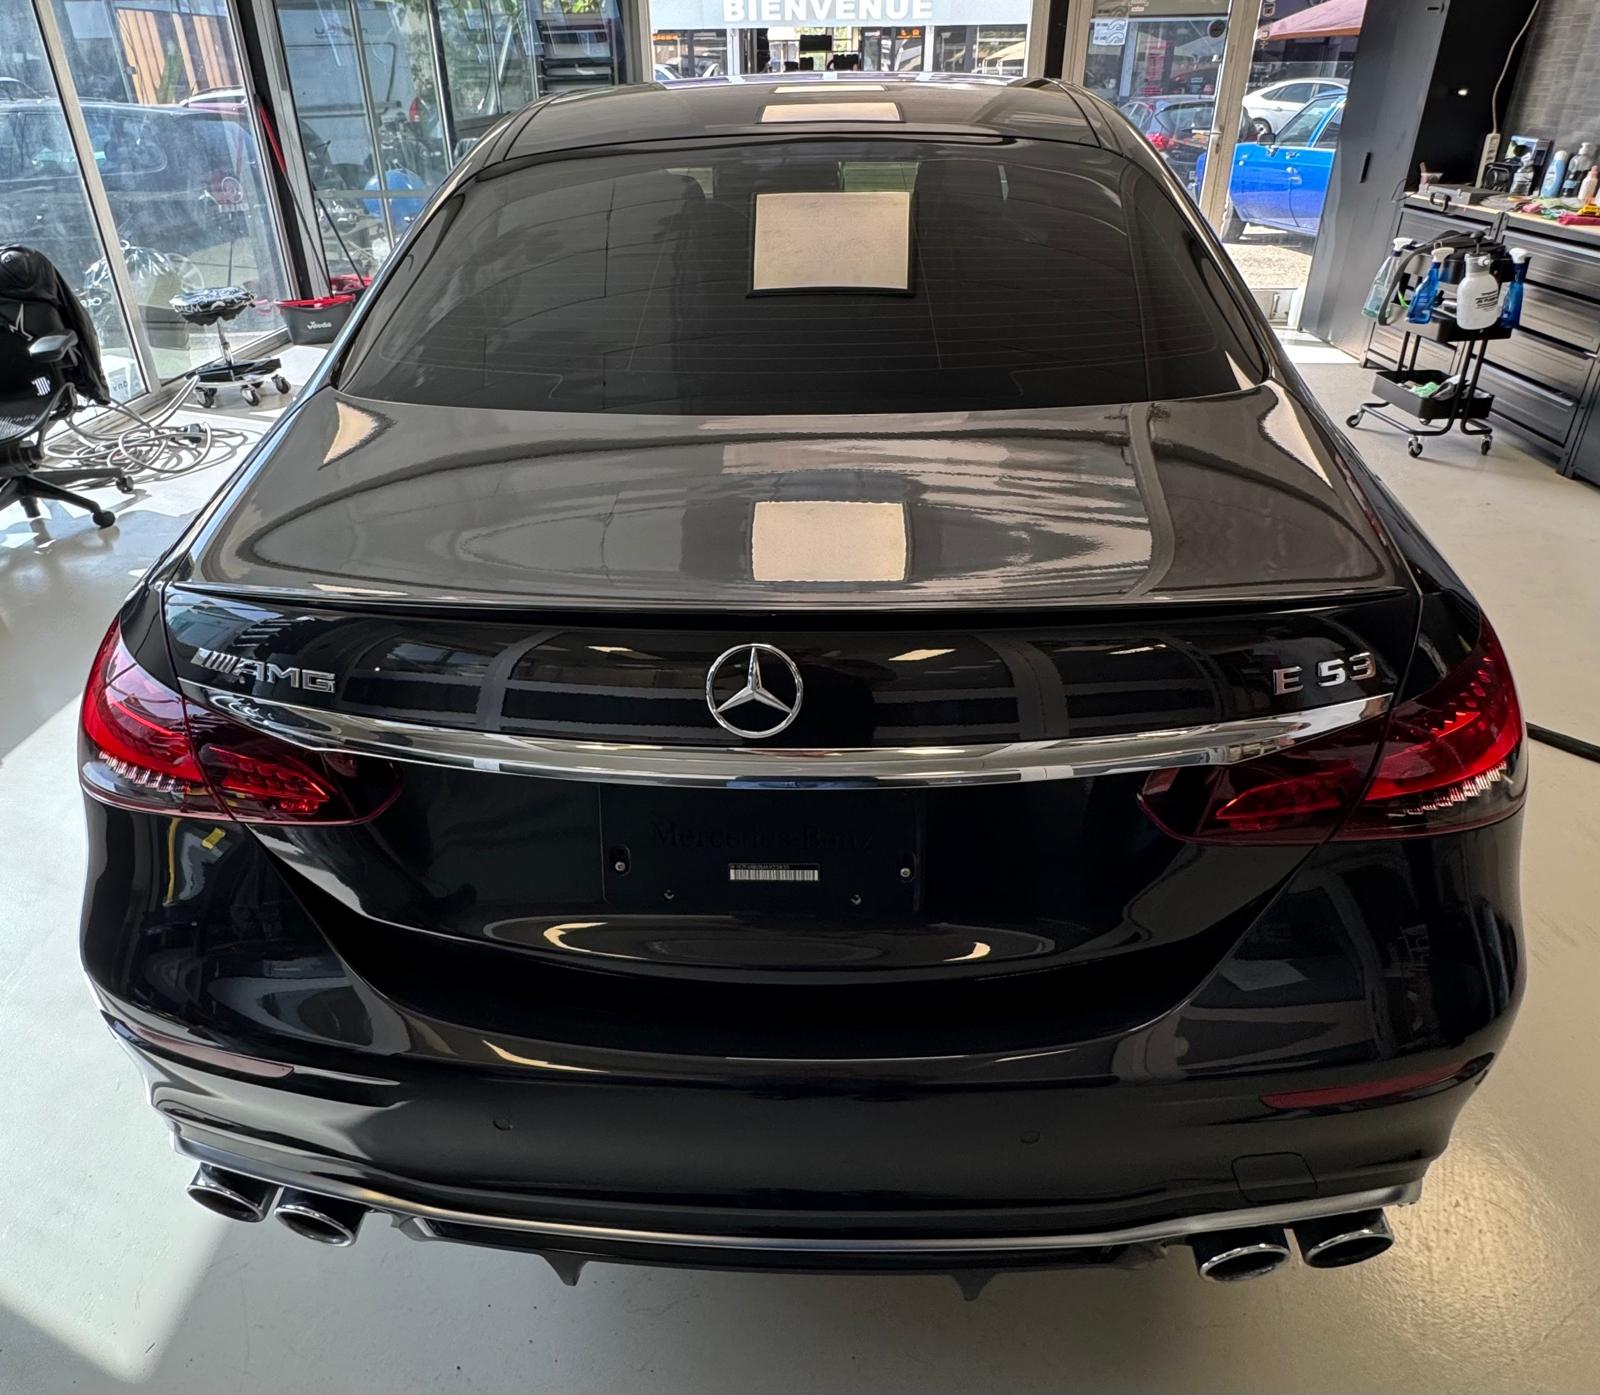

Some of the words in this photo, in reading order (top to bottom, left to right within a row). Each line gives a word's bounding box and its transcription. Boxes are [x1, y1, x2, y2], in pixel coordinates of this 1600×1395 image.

[723, 0, 933, 22] BIENVENUE
[232, 657, 336, 694] AMG
[1273, 665, 1304, 696] E
[1316, 651, 1377, 687] 53
